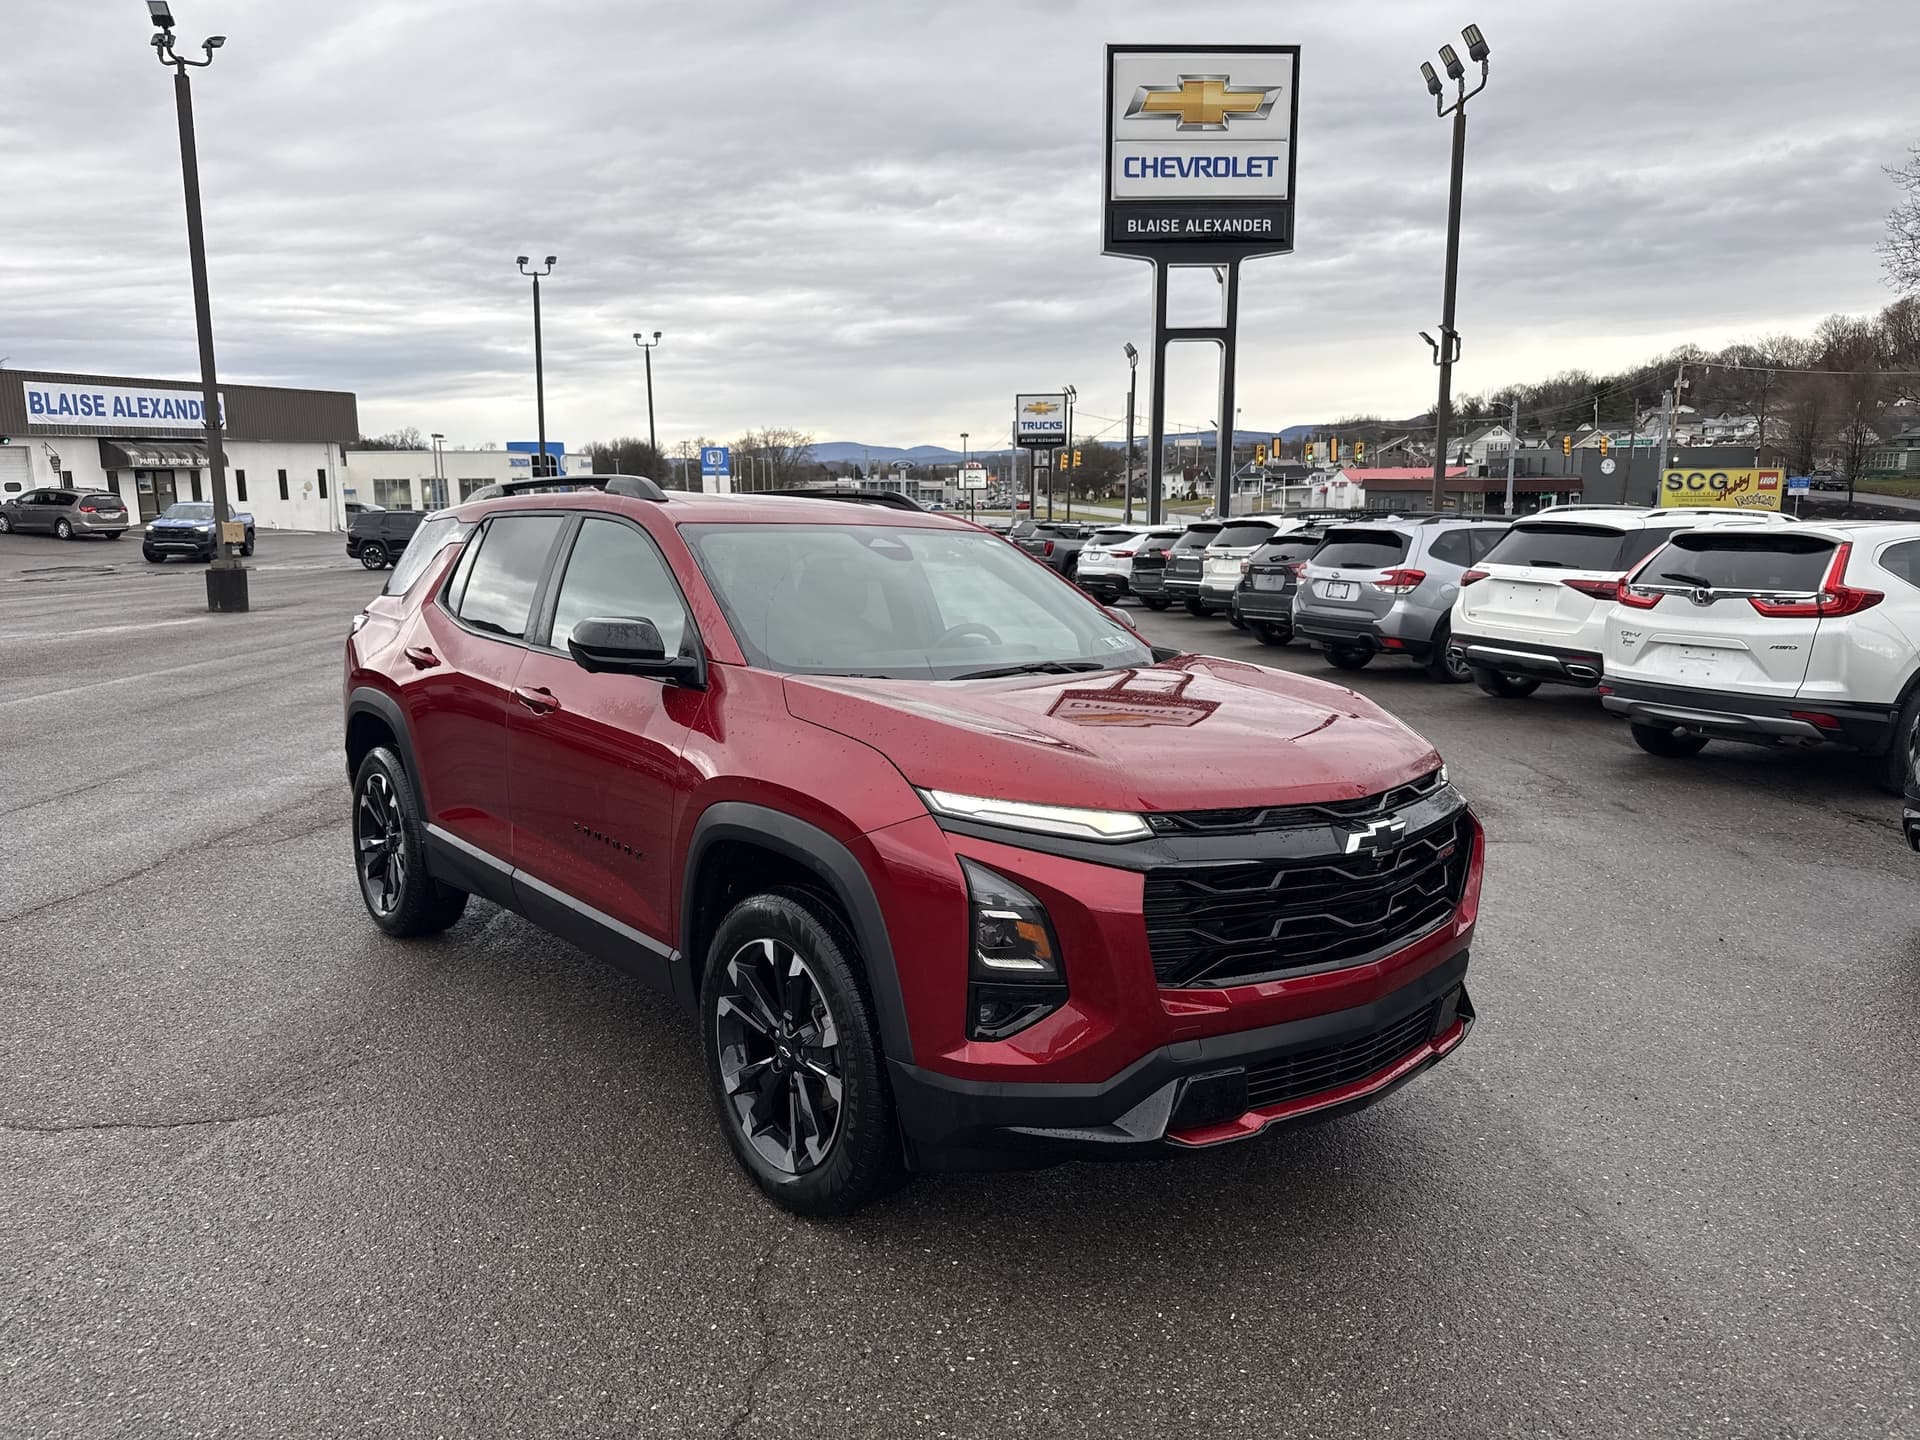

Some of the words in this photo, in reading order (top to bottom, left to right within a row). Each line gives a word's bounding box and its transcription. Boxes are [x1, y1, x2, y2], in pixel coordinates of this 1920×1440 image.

[1124, 156, 1279, 178] CHEVROLET
[1127, 219, 1180, 233] BLAISE
[1185, 218, 1272, 232] ALEXANDER
[28, 391, 107, 417] BLAISE
[1021, 421, 1063, 430] TRUCKS
[1665, 472, 1728, 491] SCG
[1715, 473, 1751, 501] Hobby
[1759, 476, 1777, 485] LEGO
